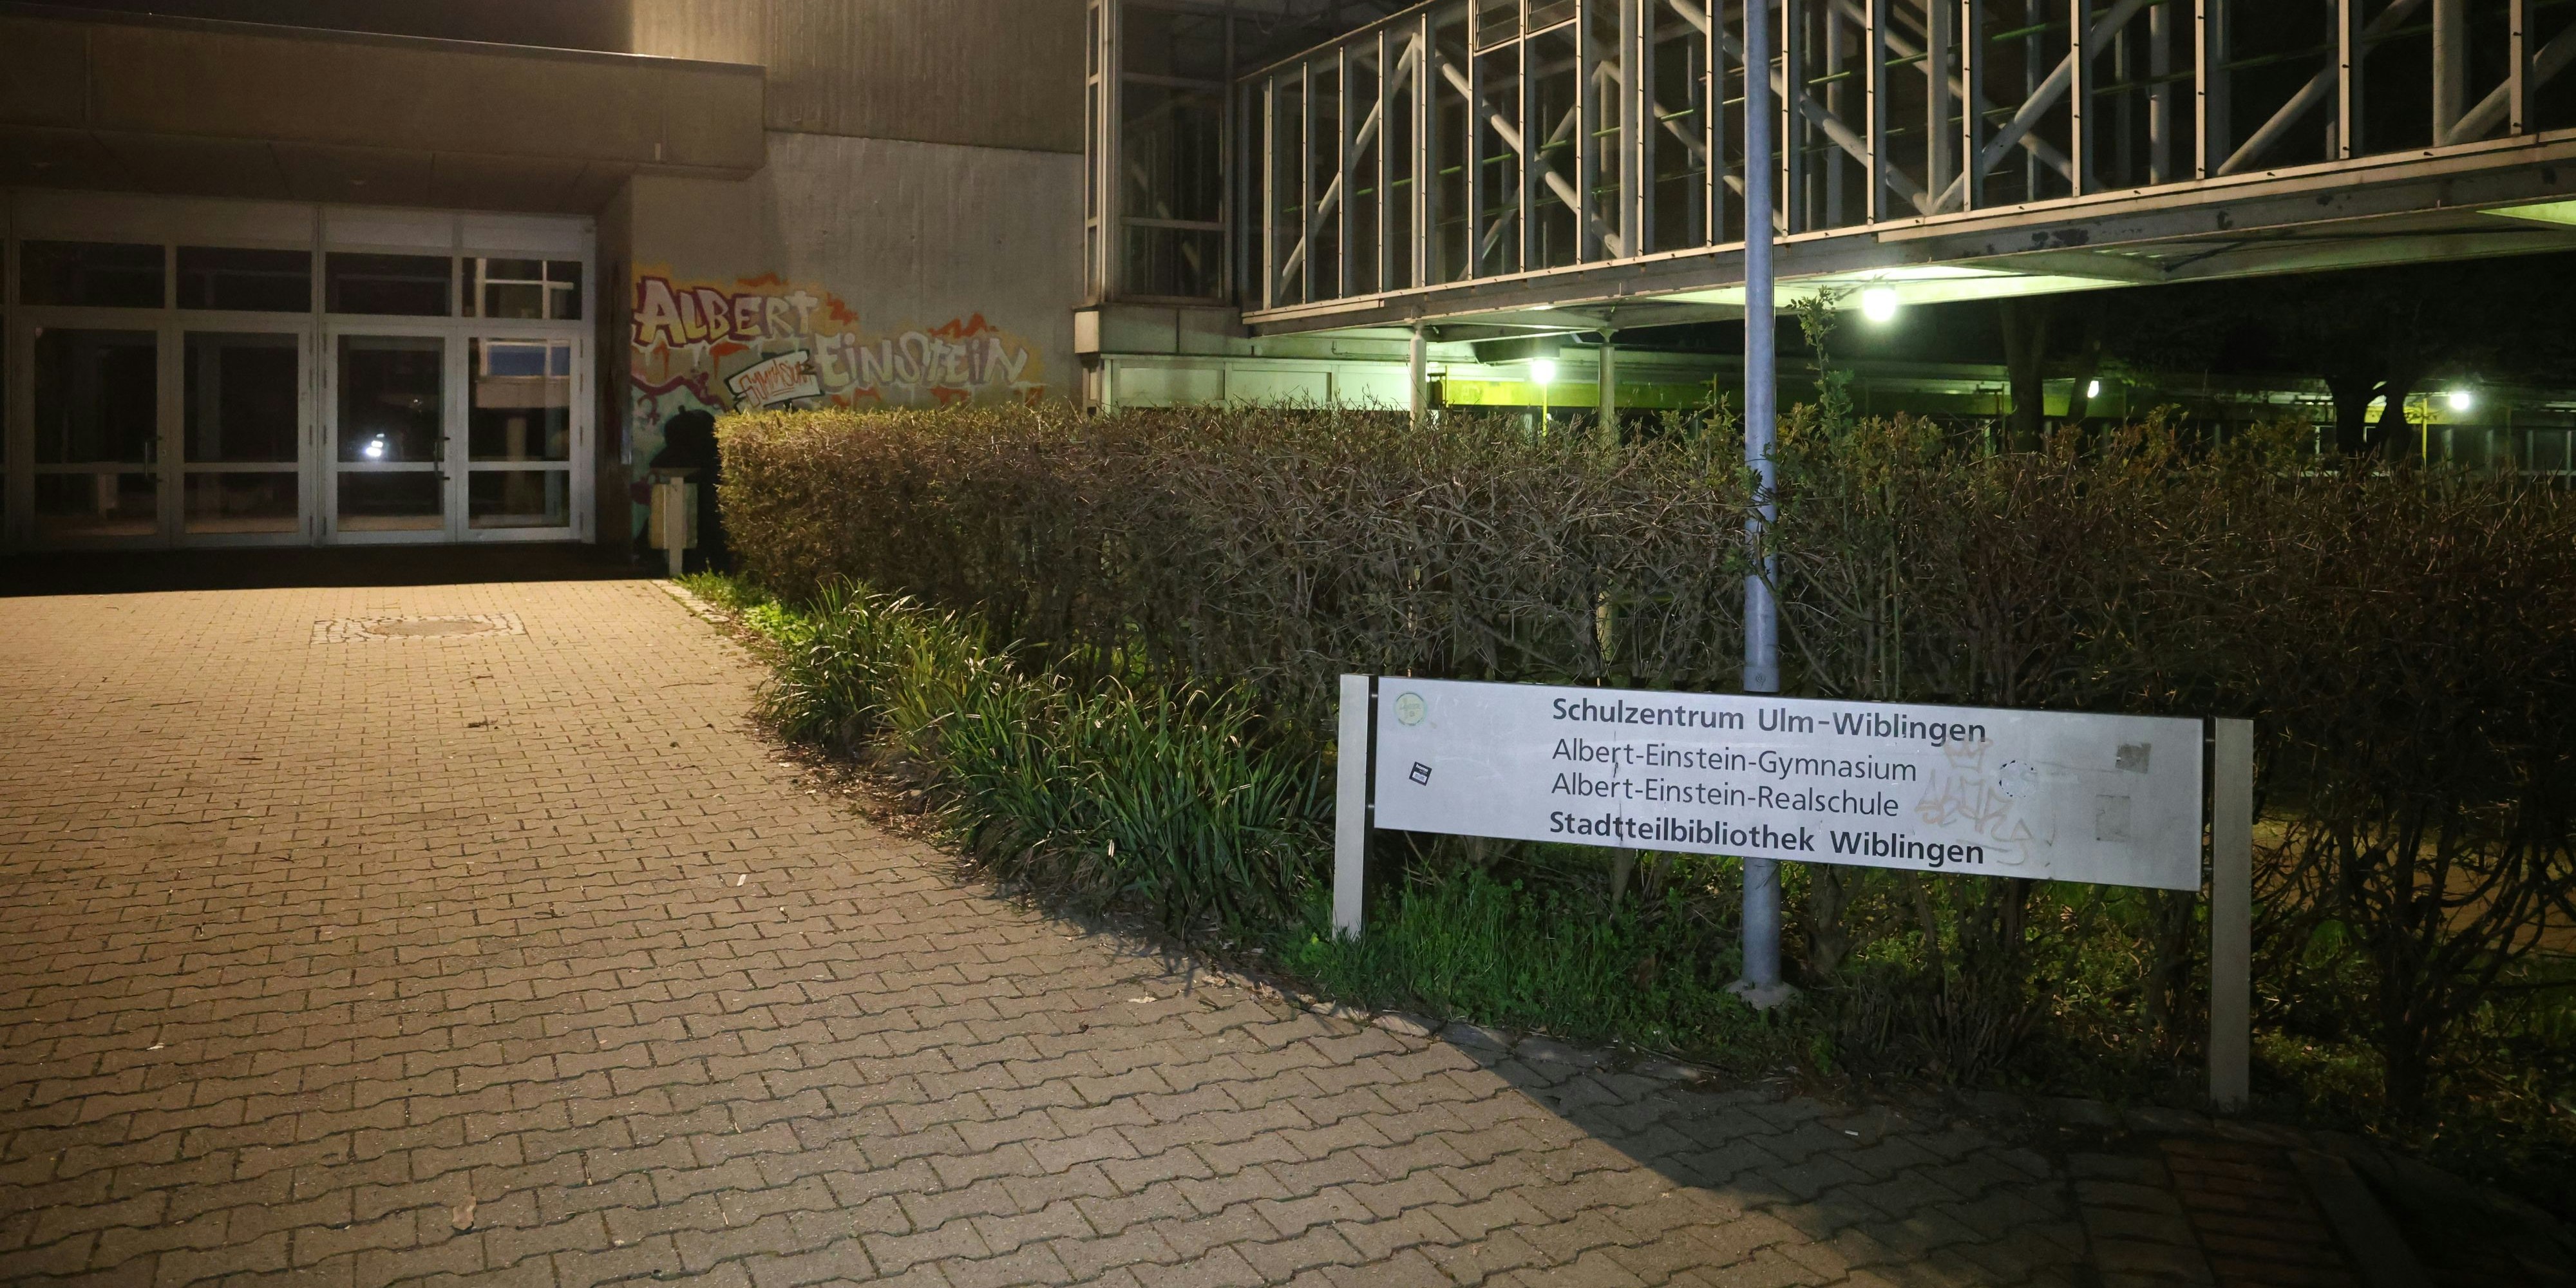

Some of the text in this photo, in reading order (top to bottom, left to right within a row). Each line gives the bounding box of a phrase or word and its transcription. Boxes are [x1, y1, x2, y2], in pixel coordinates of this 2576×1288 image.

[634, 276, 818, 346] ALBERT
[1553, 697, 1986, 747] Schulzentrum Ulm-Wiblingen
[1552, 737, 1917, 781] Albert-Einstein-Gymnasium
[1551, 772, 1899, 817] Albert-Einstein-Realschule
[1549, 811, 1984, 867] Stadtteilbibliothek Wiblingen
